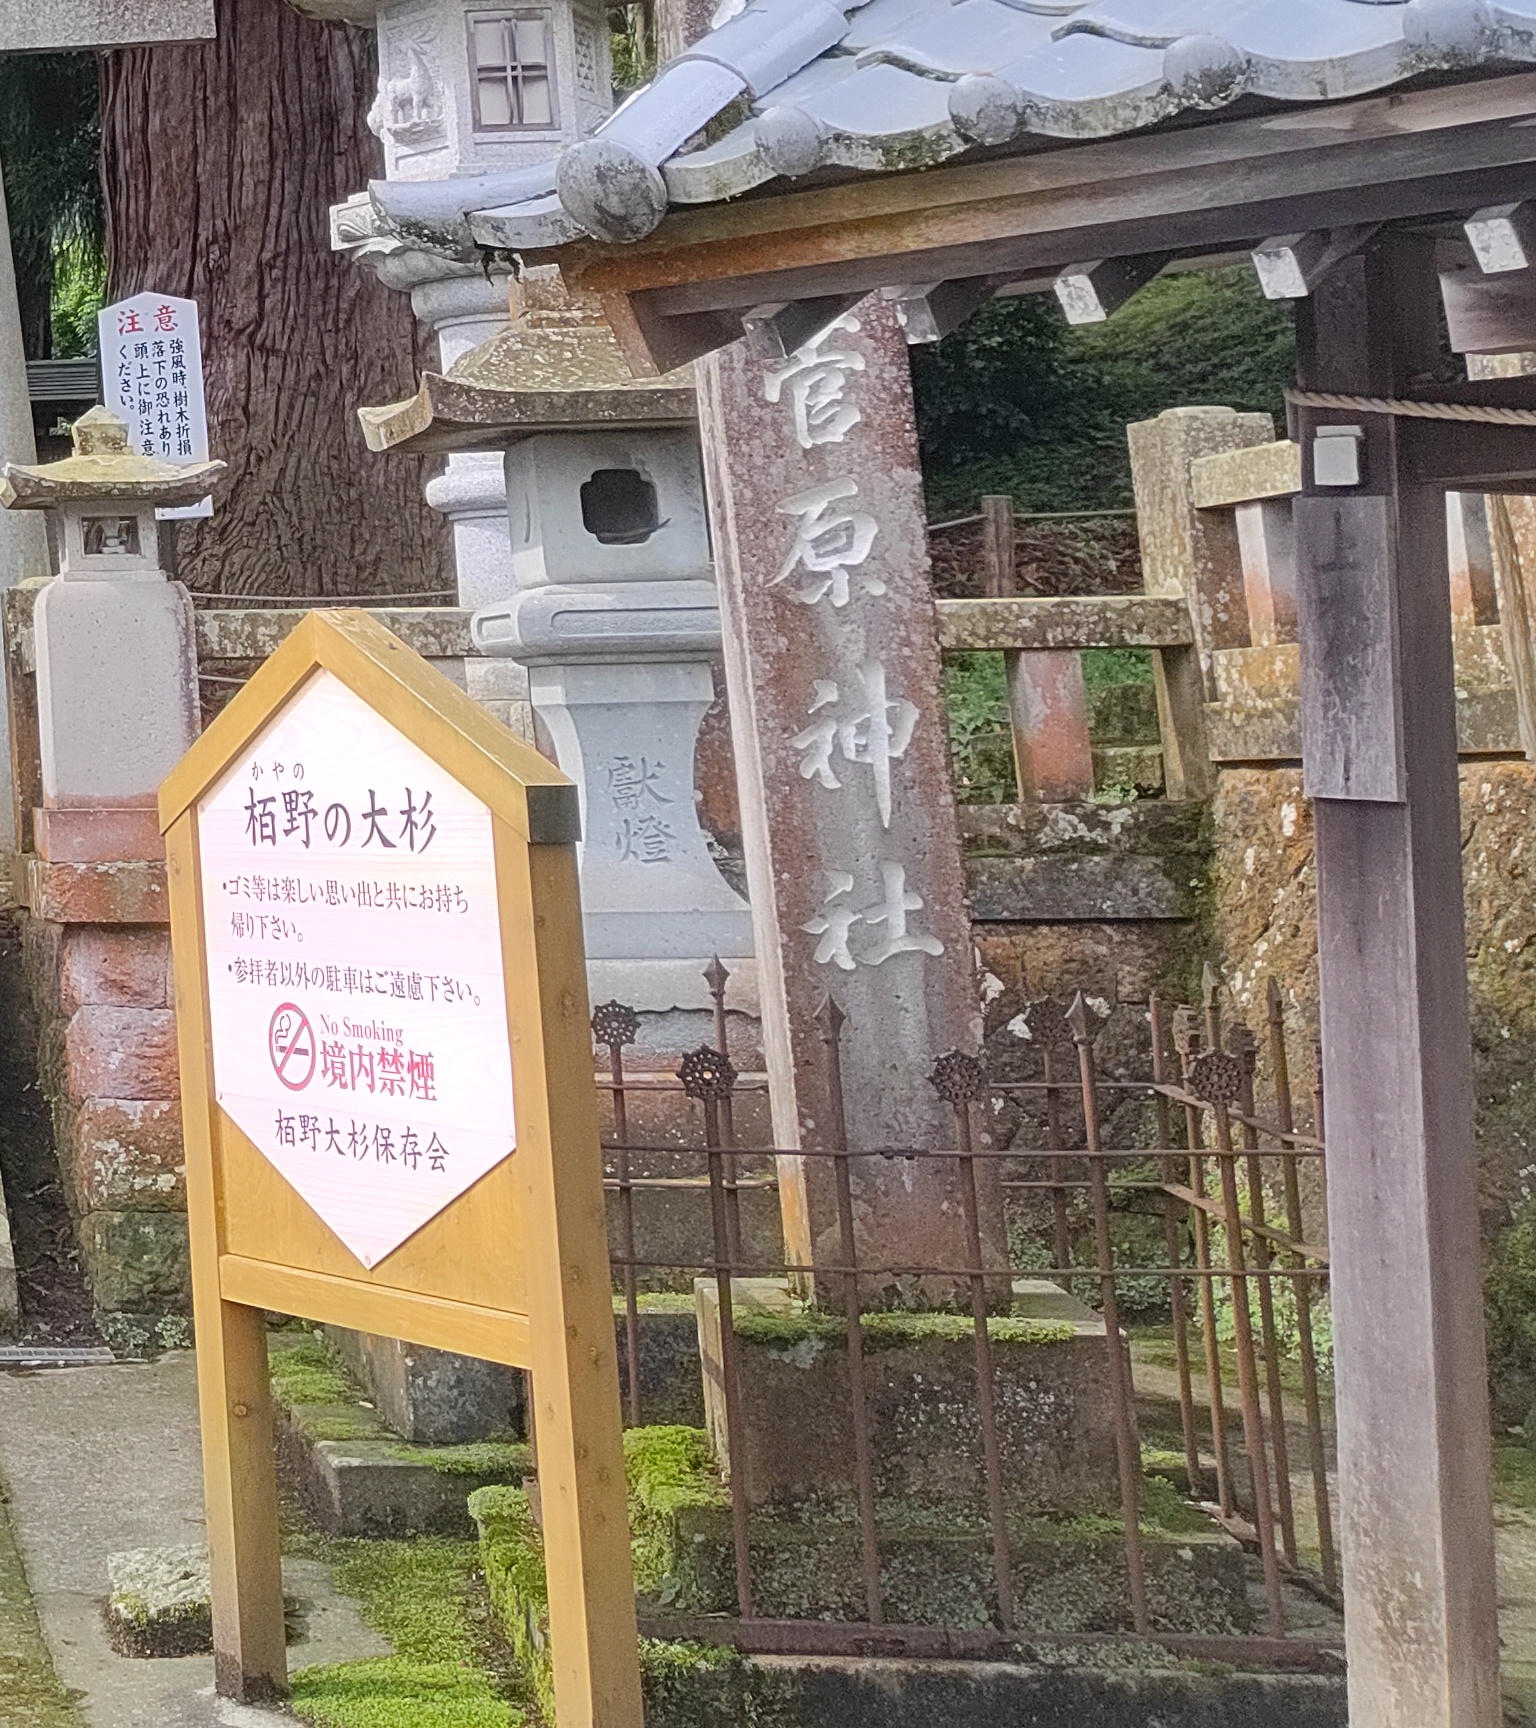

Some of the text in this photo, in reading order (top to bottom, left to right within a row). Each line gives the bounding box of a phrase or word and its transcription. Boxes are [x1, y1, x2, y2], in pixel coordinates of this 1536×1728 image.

[118, 304, 179, 336] 注意
[118, 344, 135, 411] ください。
[134, 341, 157, 457] 頭上に御注意
[151, 340, 173, 458] 落下の恐れあり
[169, 337, 193, 456] 強風時、樹木折損
[251, 761, 305, 781] かやの
[244, 786, 437, 854] 栢野の大杉
[231, 911, 304, 943] 帰り下さい。
[320, 1013, 404, 1047] No Smoking
[320, 1039, 438, 1102] 境内禁煙
[275, 1108, 451, 1173] 栢野大杉保存会
